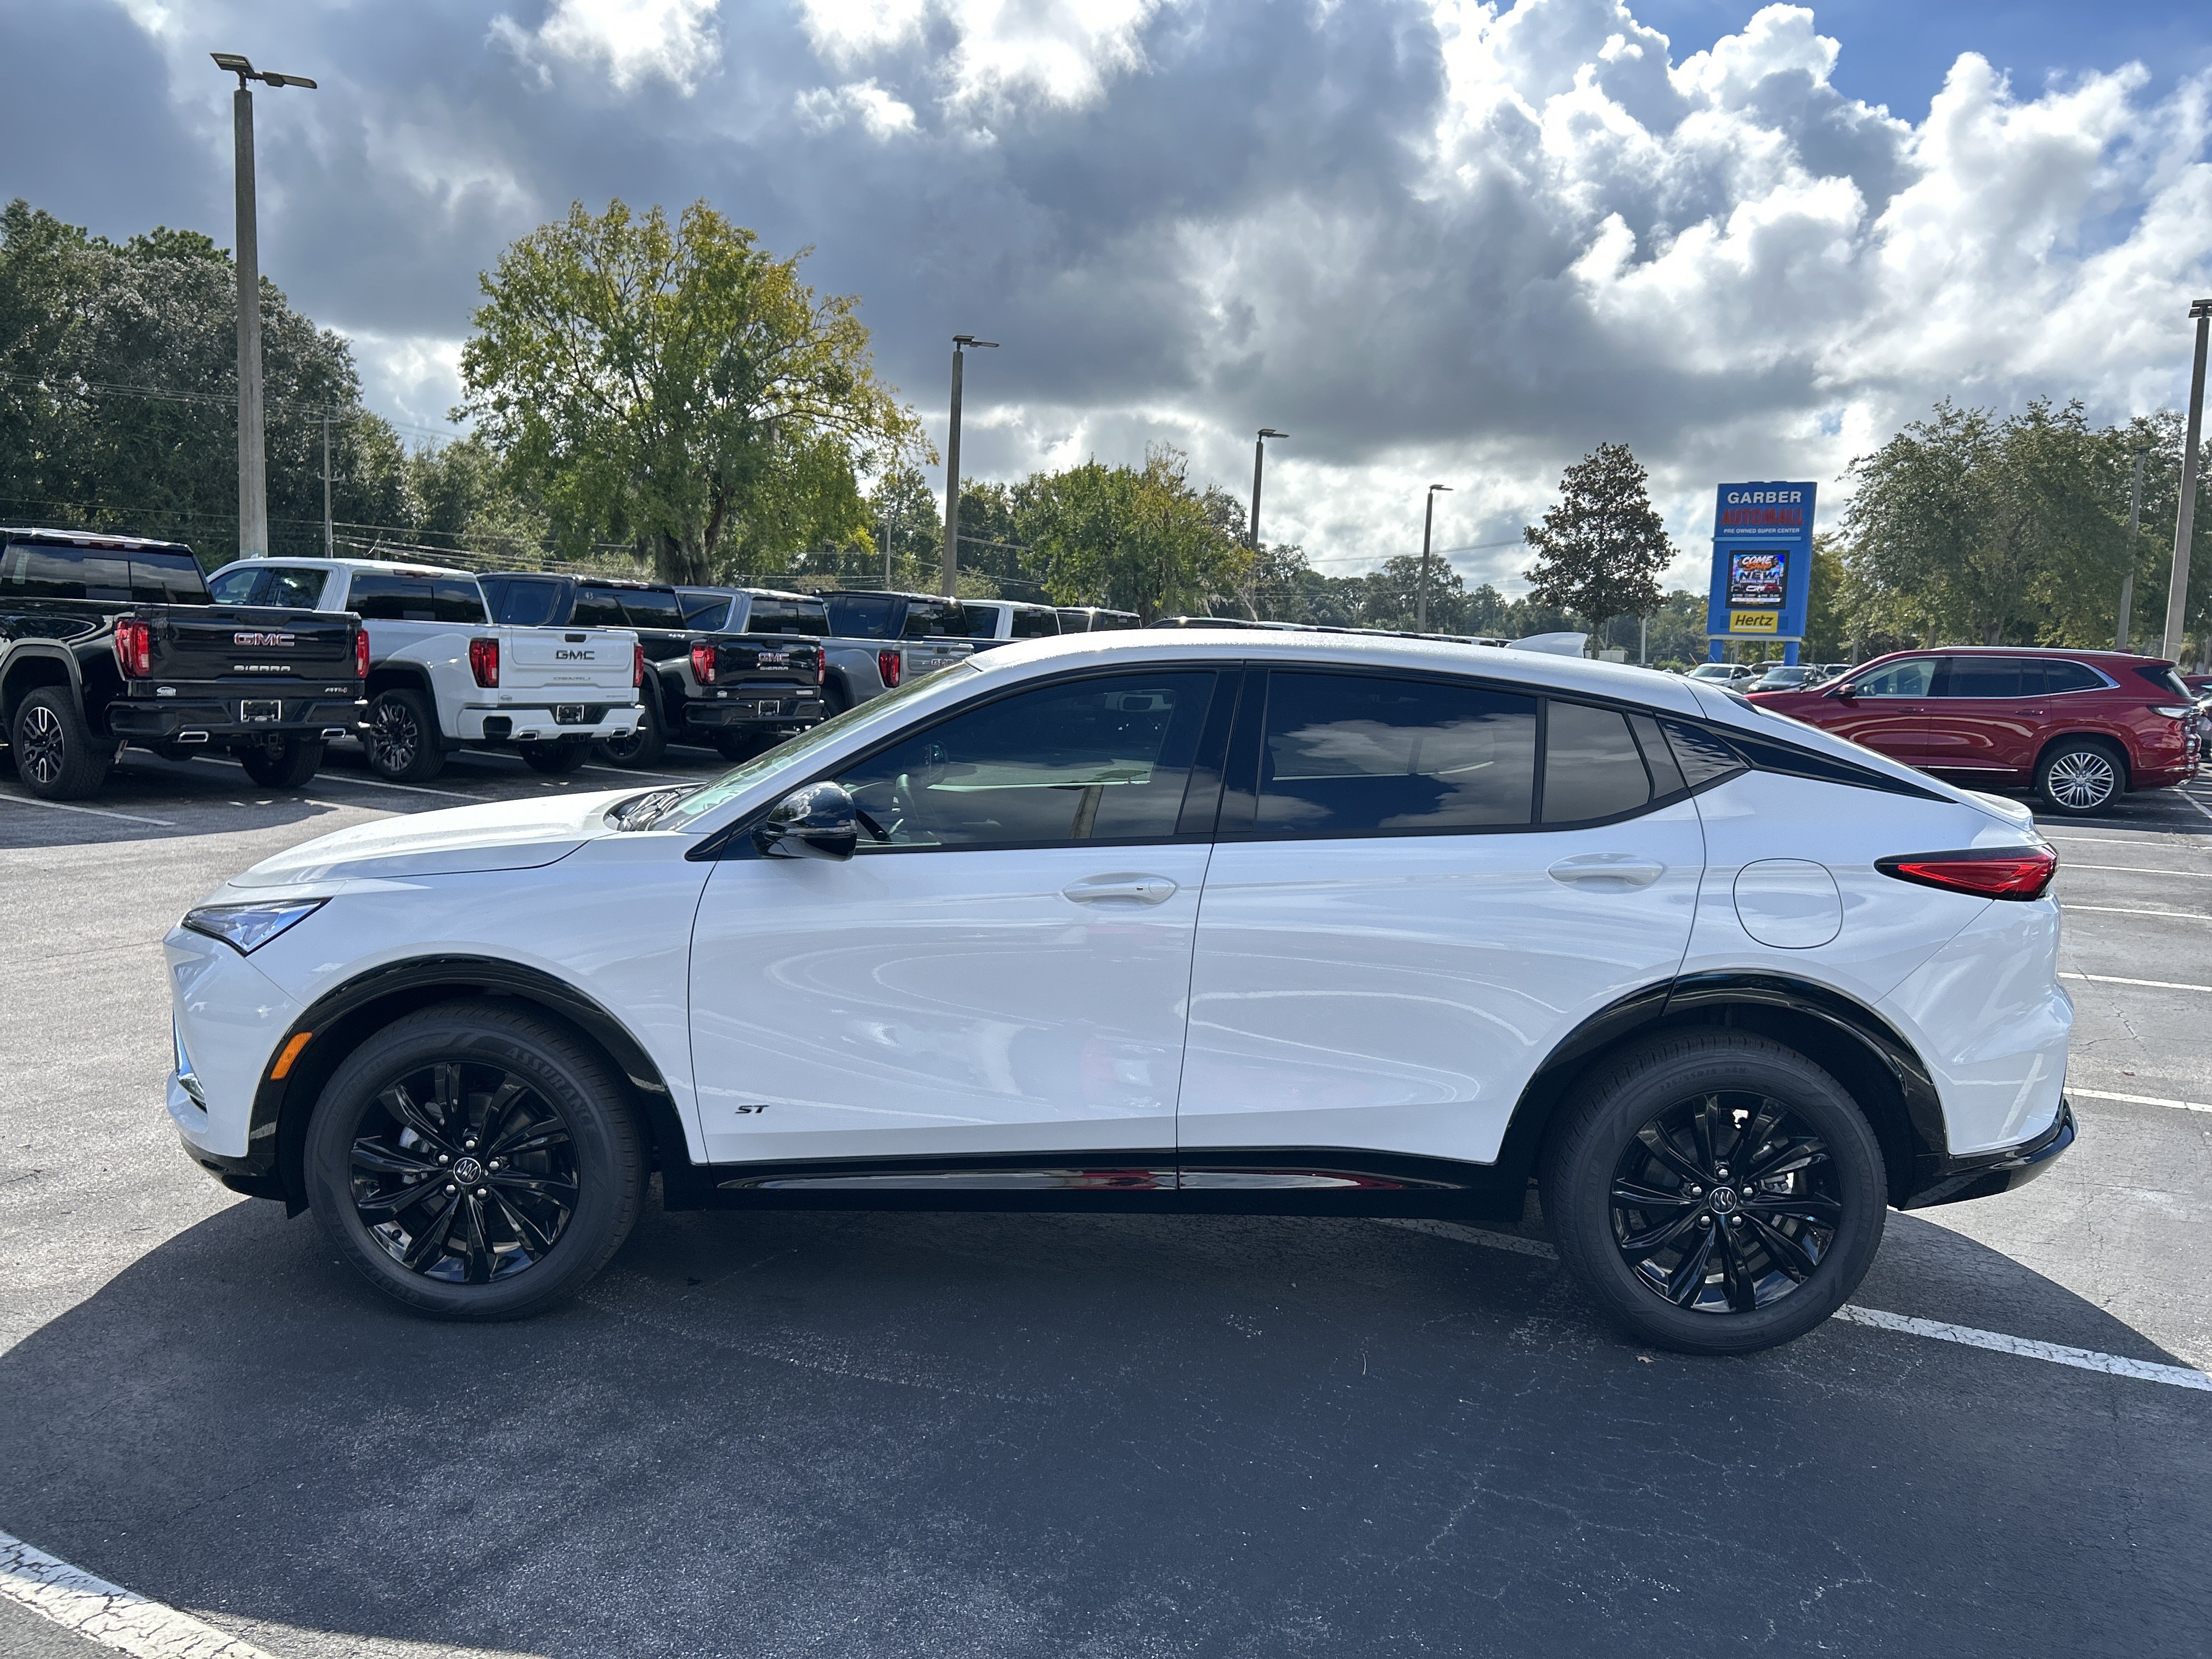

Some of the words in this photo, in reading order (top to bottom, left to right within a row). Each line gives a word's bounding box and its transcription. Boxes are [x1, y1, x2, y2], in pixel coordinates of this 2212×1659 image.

[1727, 491, 1802, 504] GARBER
[1742, 555, 1774, 565] COME
[1739, 571, 1778, 579] NEW
[1735, 614, 1774, 626] Hertz
[234, 633, 295, 646] GMC
[555, 650, 595, 660] GMC
[758, 653, 790, 662] GMC
[504, 1046, 599, 1136] ASSURANCE
[735, 1104, 770, 1114] ST
